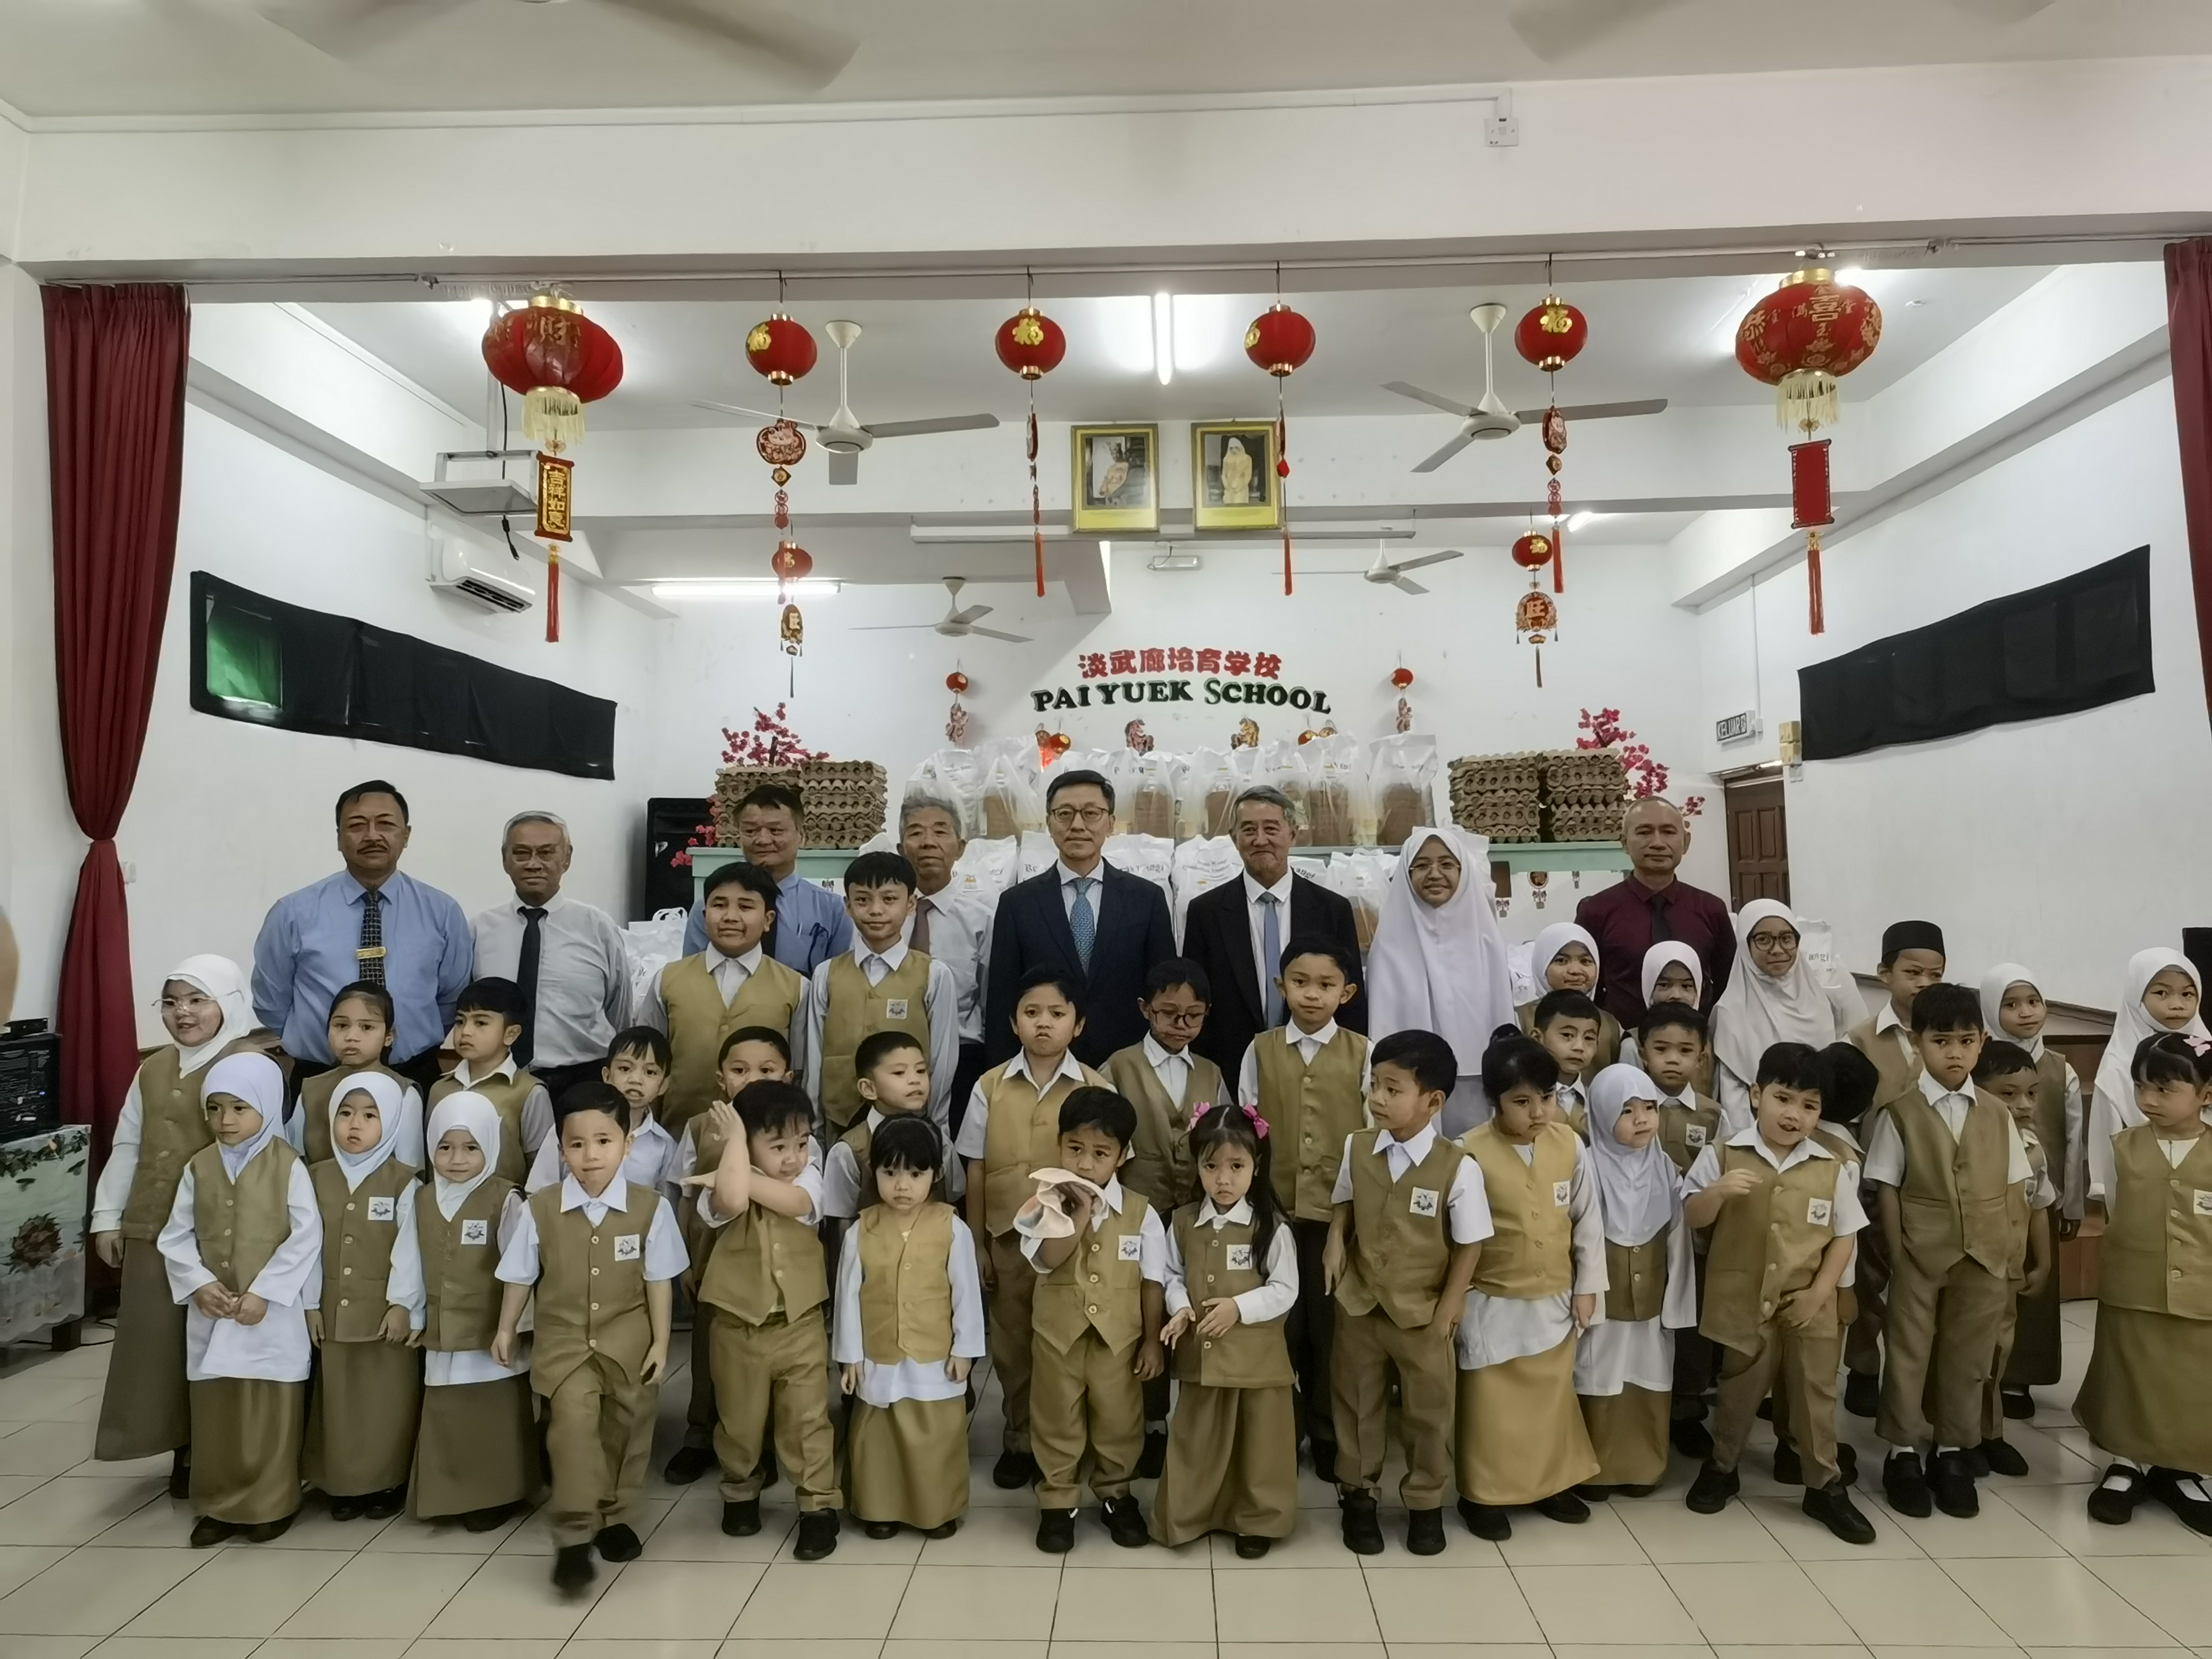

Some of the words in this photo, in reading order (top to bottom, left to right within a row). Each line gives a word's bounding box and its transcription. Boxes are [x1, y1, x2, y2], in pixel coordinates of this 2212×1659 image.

[1809, 295, 1840, 322] 喜
[548, 470, 566, 530] 吉祥如意
[1030, 684, 1091, 712] PAI
[1095, 680, 1193, 704] YUEK
[1204, 677, 1331, 714] SCHOOL
